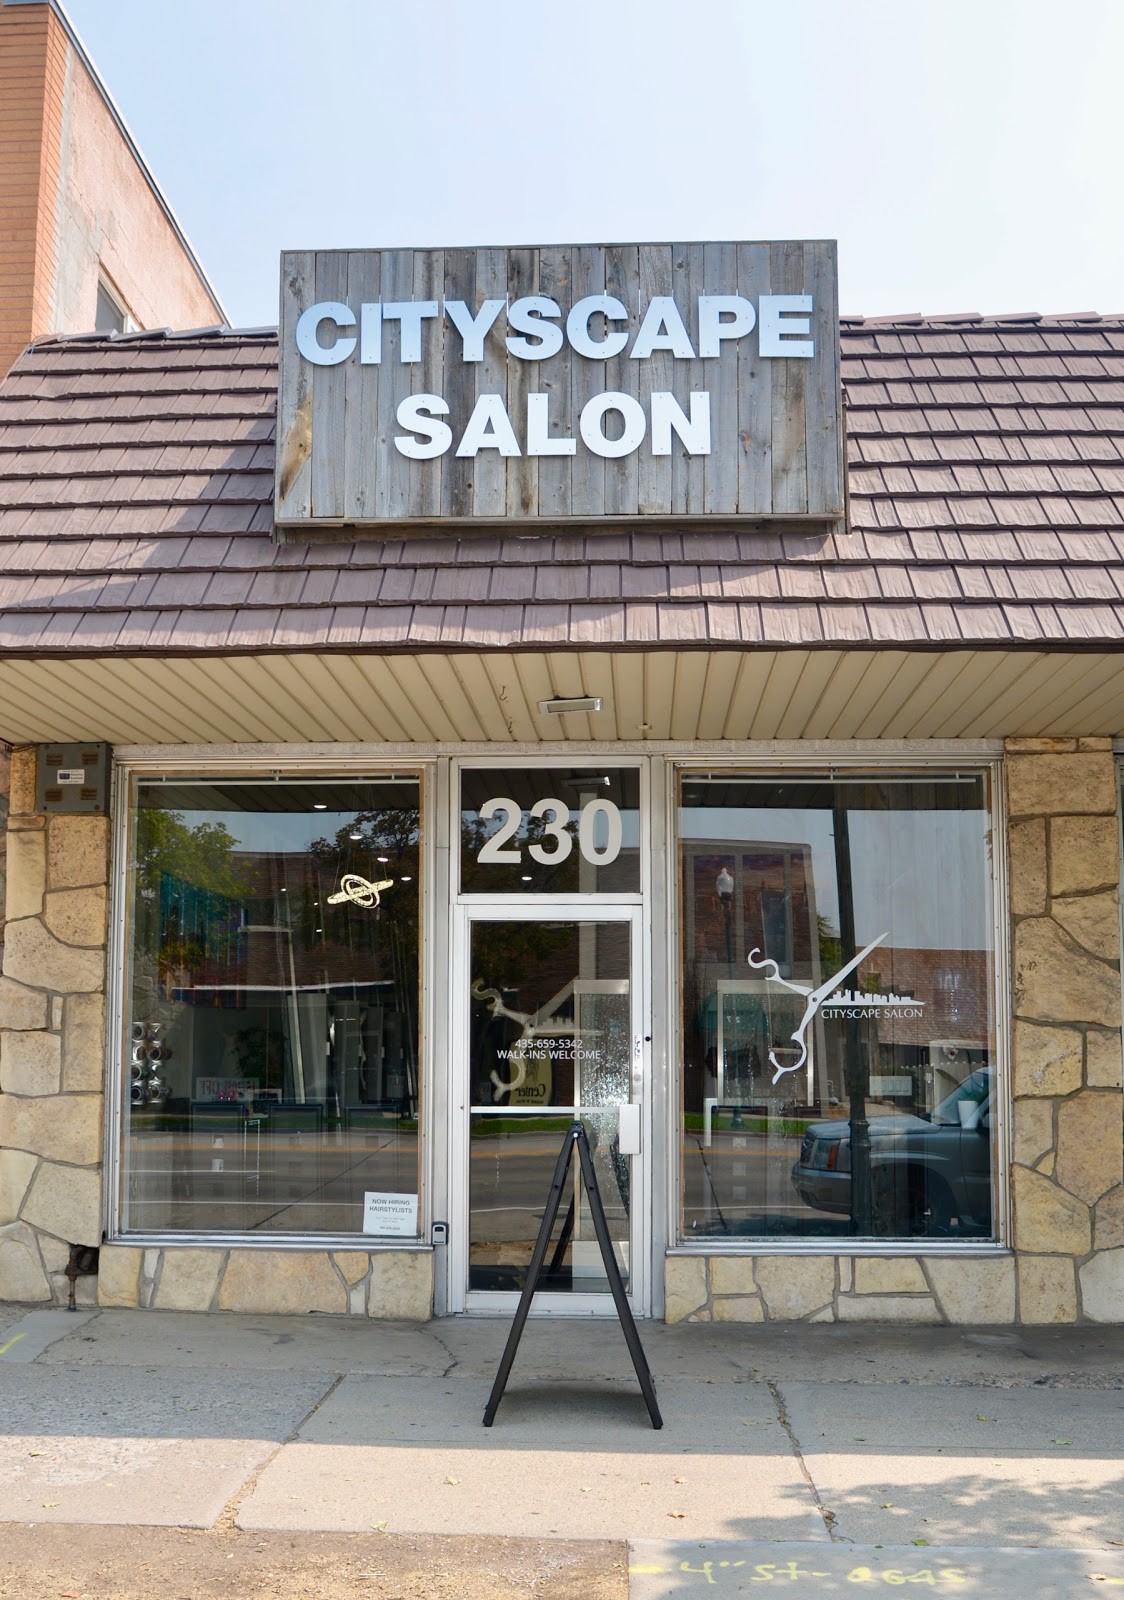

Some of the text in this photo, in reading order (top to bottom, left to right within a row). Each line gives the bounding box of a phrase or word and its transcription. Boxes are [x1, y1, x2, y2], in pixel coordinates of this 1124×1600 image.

[296, 294, 815, 367] CITYSCAPE
[394, 391, 712, 461] SALON
[477, 797, 623, 866] 230
[821, 1008, 923, 1019] CITYSCAPE SALON
[514, 1039, 583, 1049] 435-659-5342
[497, 1049, 601, 1060] WALK-INS WELCOME
[369, 1206, 413, 1214] HAIRSTYLISTS
